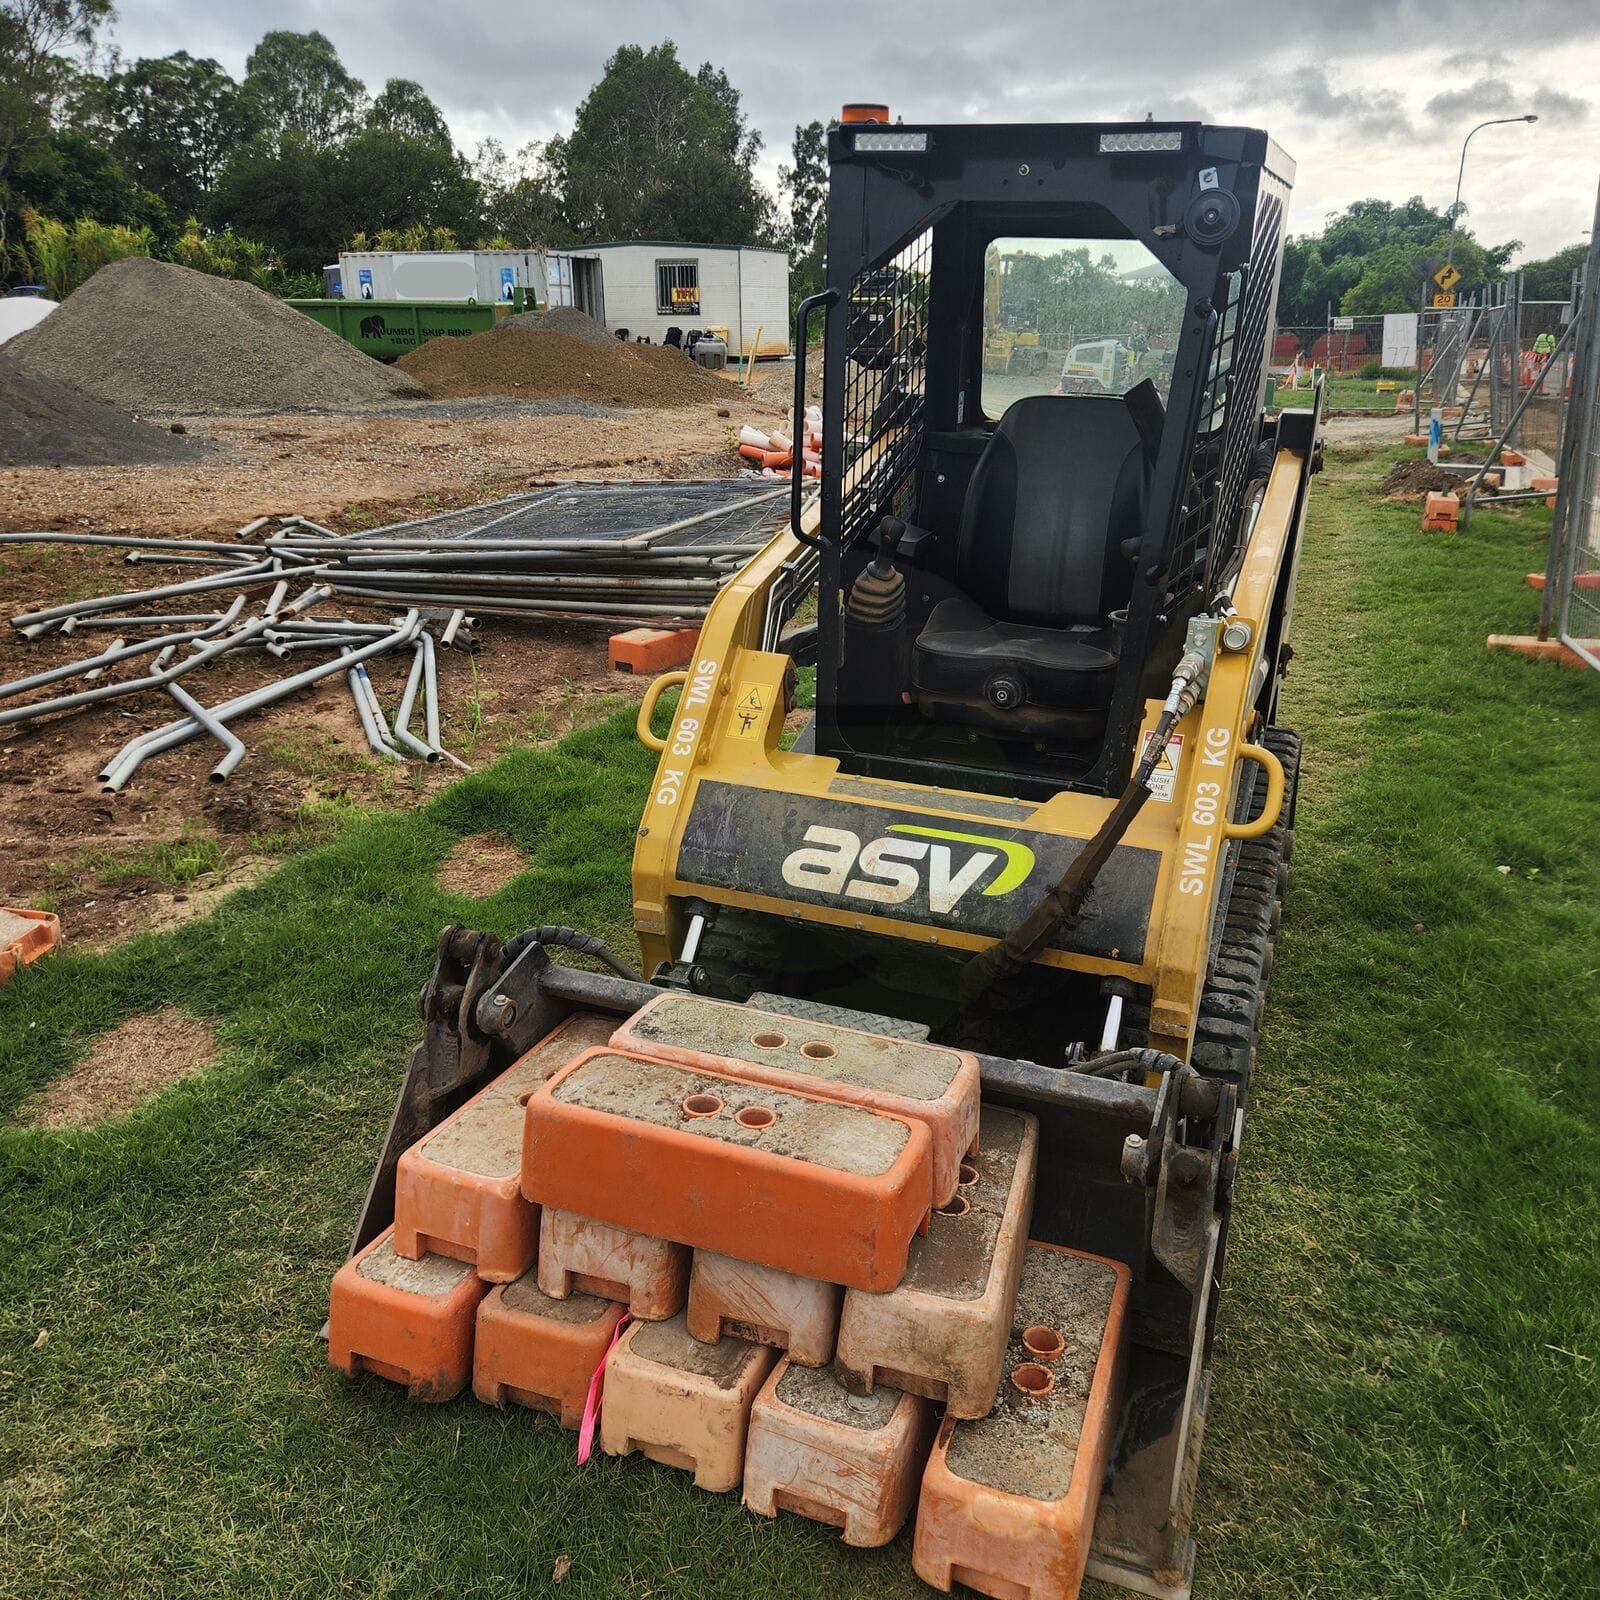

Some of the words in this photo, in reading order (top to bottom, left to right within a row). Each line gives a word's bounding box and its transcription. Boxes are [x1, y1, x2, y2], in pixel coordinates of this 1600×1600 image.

[1437, 295, 1451, 304] 20
[391, 338, 416, 346] 1800
[422, 329, 445, 337] SKIP
[448, 329, 473, 337] BINS
[1386, 346, 1410, 366] 77
[685, 659, 718, 710] SWL
[672, 717, 699, 756] 603
[1202, 727, 1231, 767] KG
[656, 768, 684, 806] KG
[1191, 782, 1221, 827] 603
[1179, 835, 1212, 896] SWL
